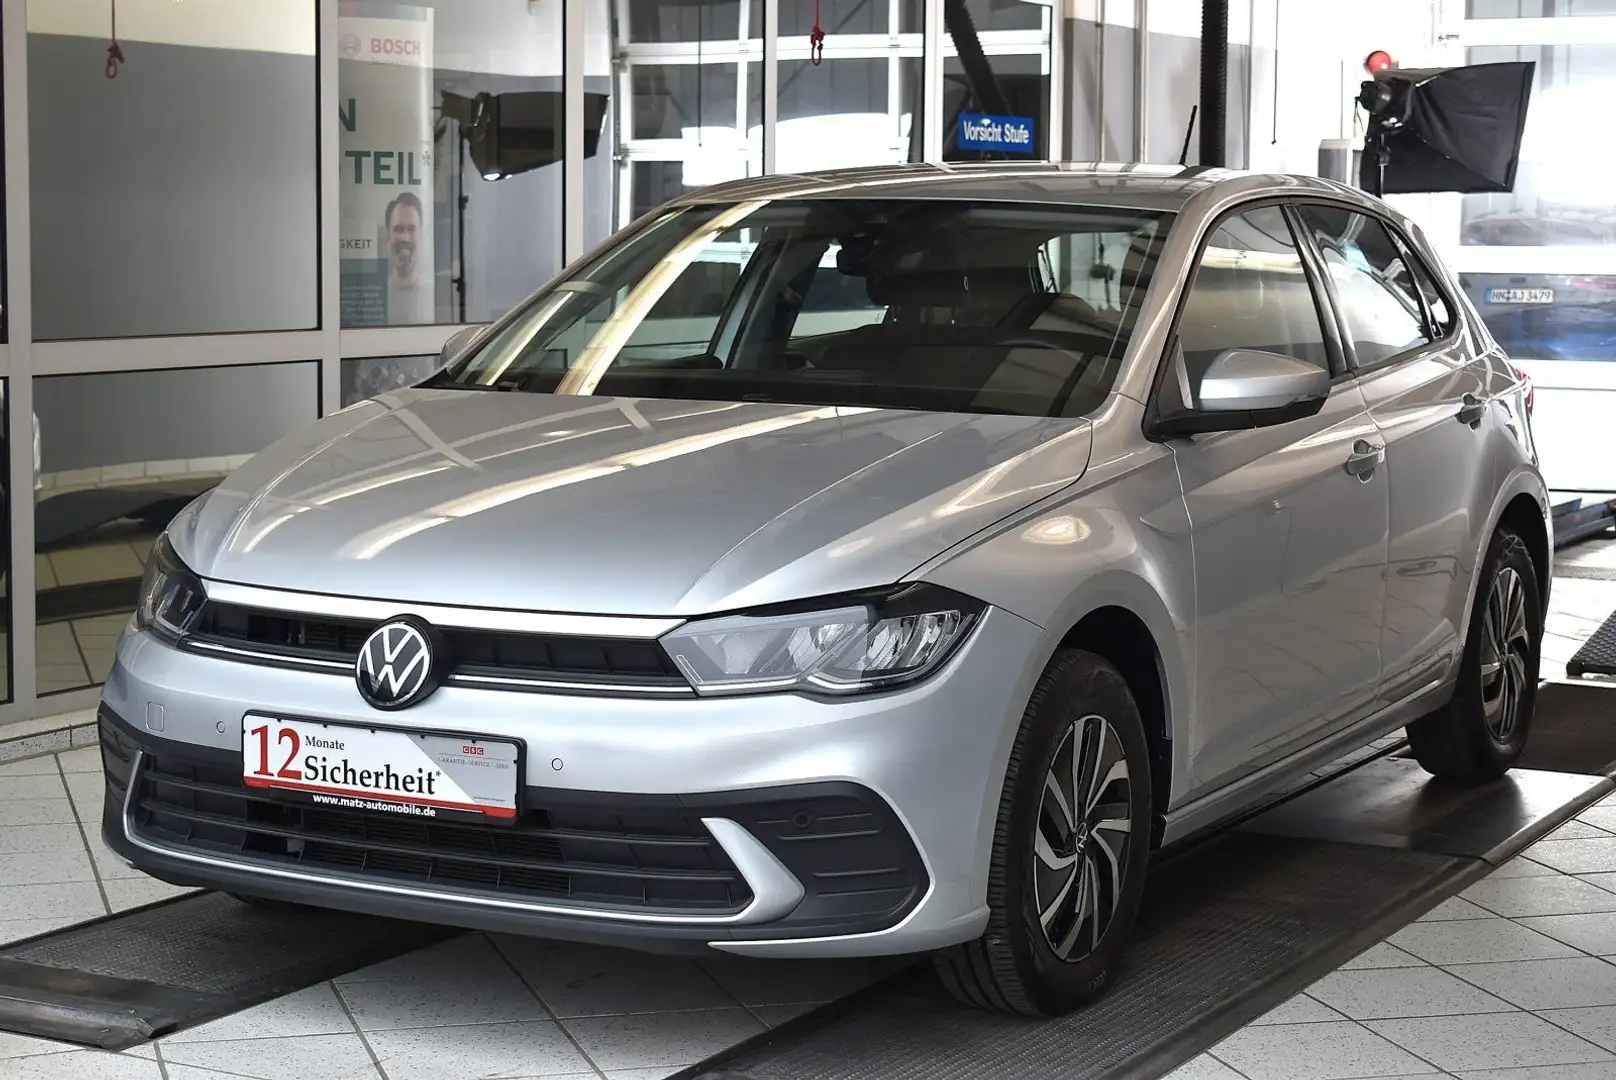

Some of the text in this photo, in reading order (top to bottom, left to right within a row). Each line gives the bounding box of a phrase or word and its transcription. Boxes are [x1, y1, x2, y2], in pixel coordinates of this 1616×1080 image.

[370, 38, 420, 56] BOSCH
[963, 119, 1030, 144] Vorsicht Stufe
[339, 150, 431, 185] TEIL
[251, 724, 302, 778] 12
[304, 735, 345, 751] Monate
[312, 794, 436, 817] www.matz-automobile.de
